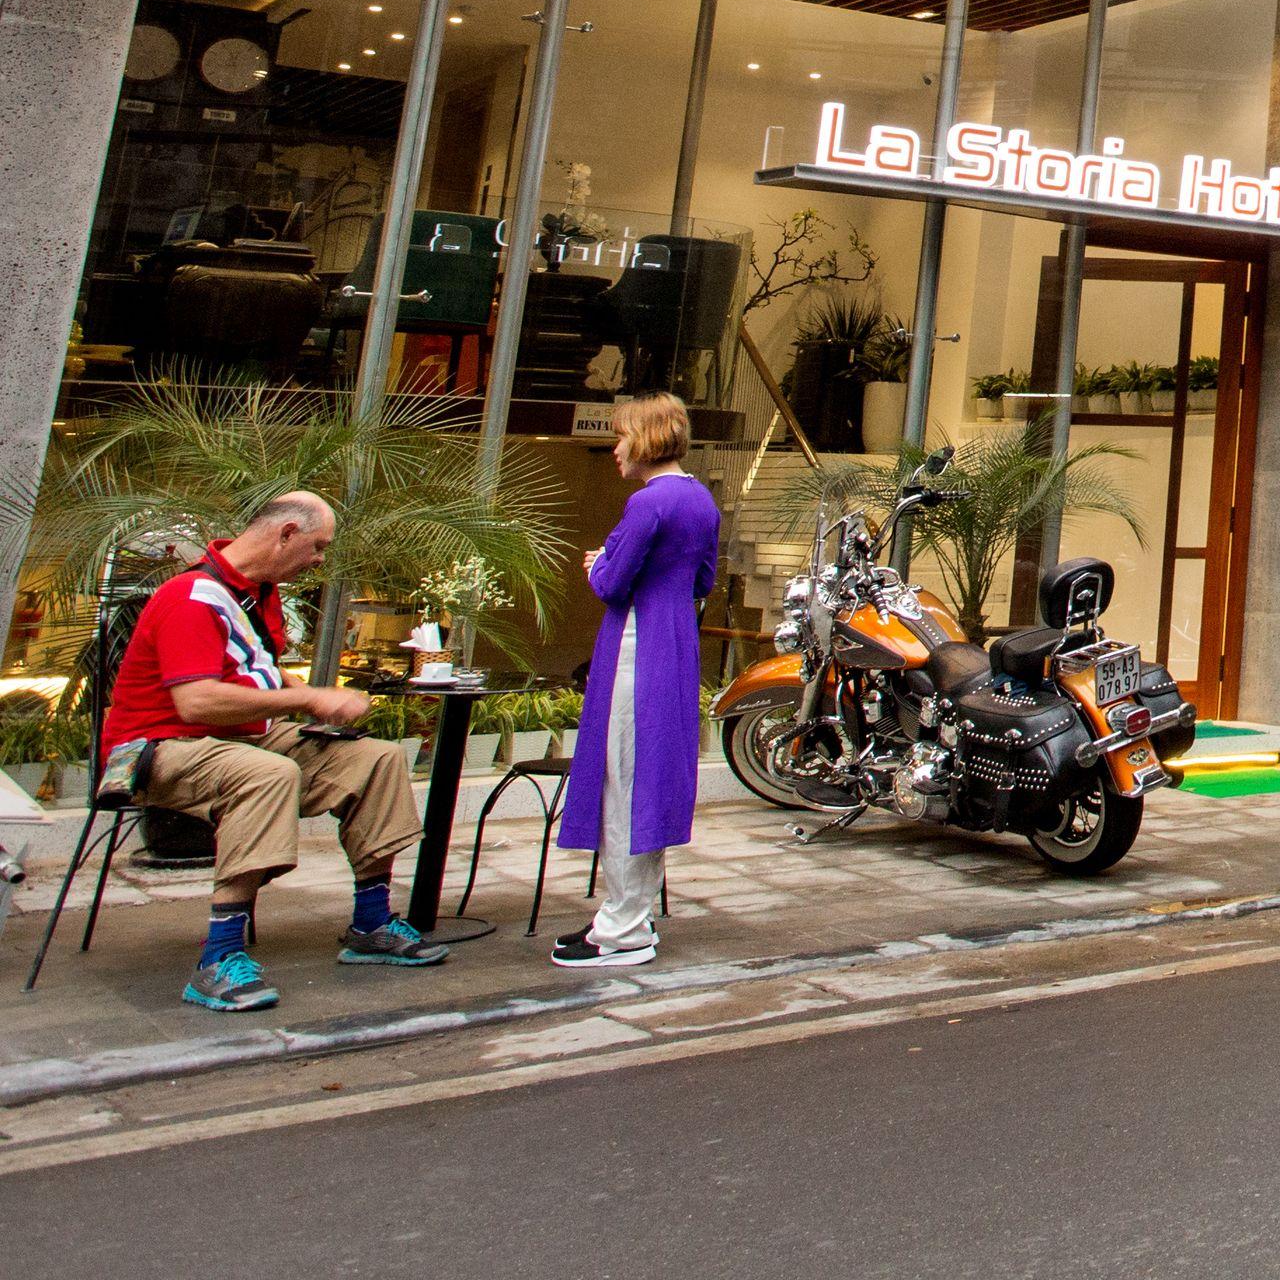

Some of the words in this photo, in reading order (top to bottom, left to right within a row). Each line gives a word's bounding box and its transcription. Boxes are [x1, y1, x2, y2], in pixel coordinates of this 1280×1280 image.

[816, 102, 920, 175] La
[945, 122, 1161, 209] Storia
[576, 419, 614, 432] RESTA
[1102, 655, 1135, 681] 59-A3
[1098, 672, 1139, 701] 078.97
